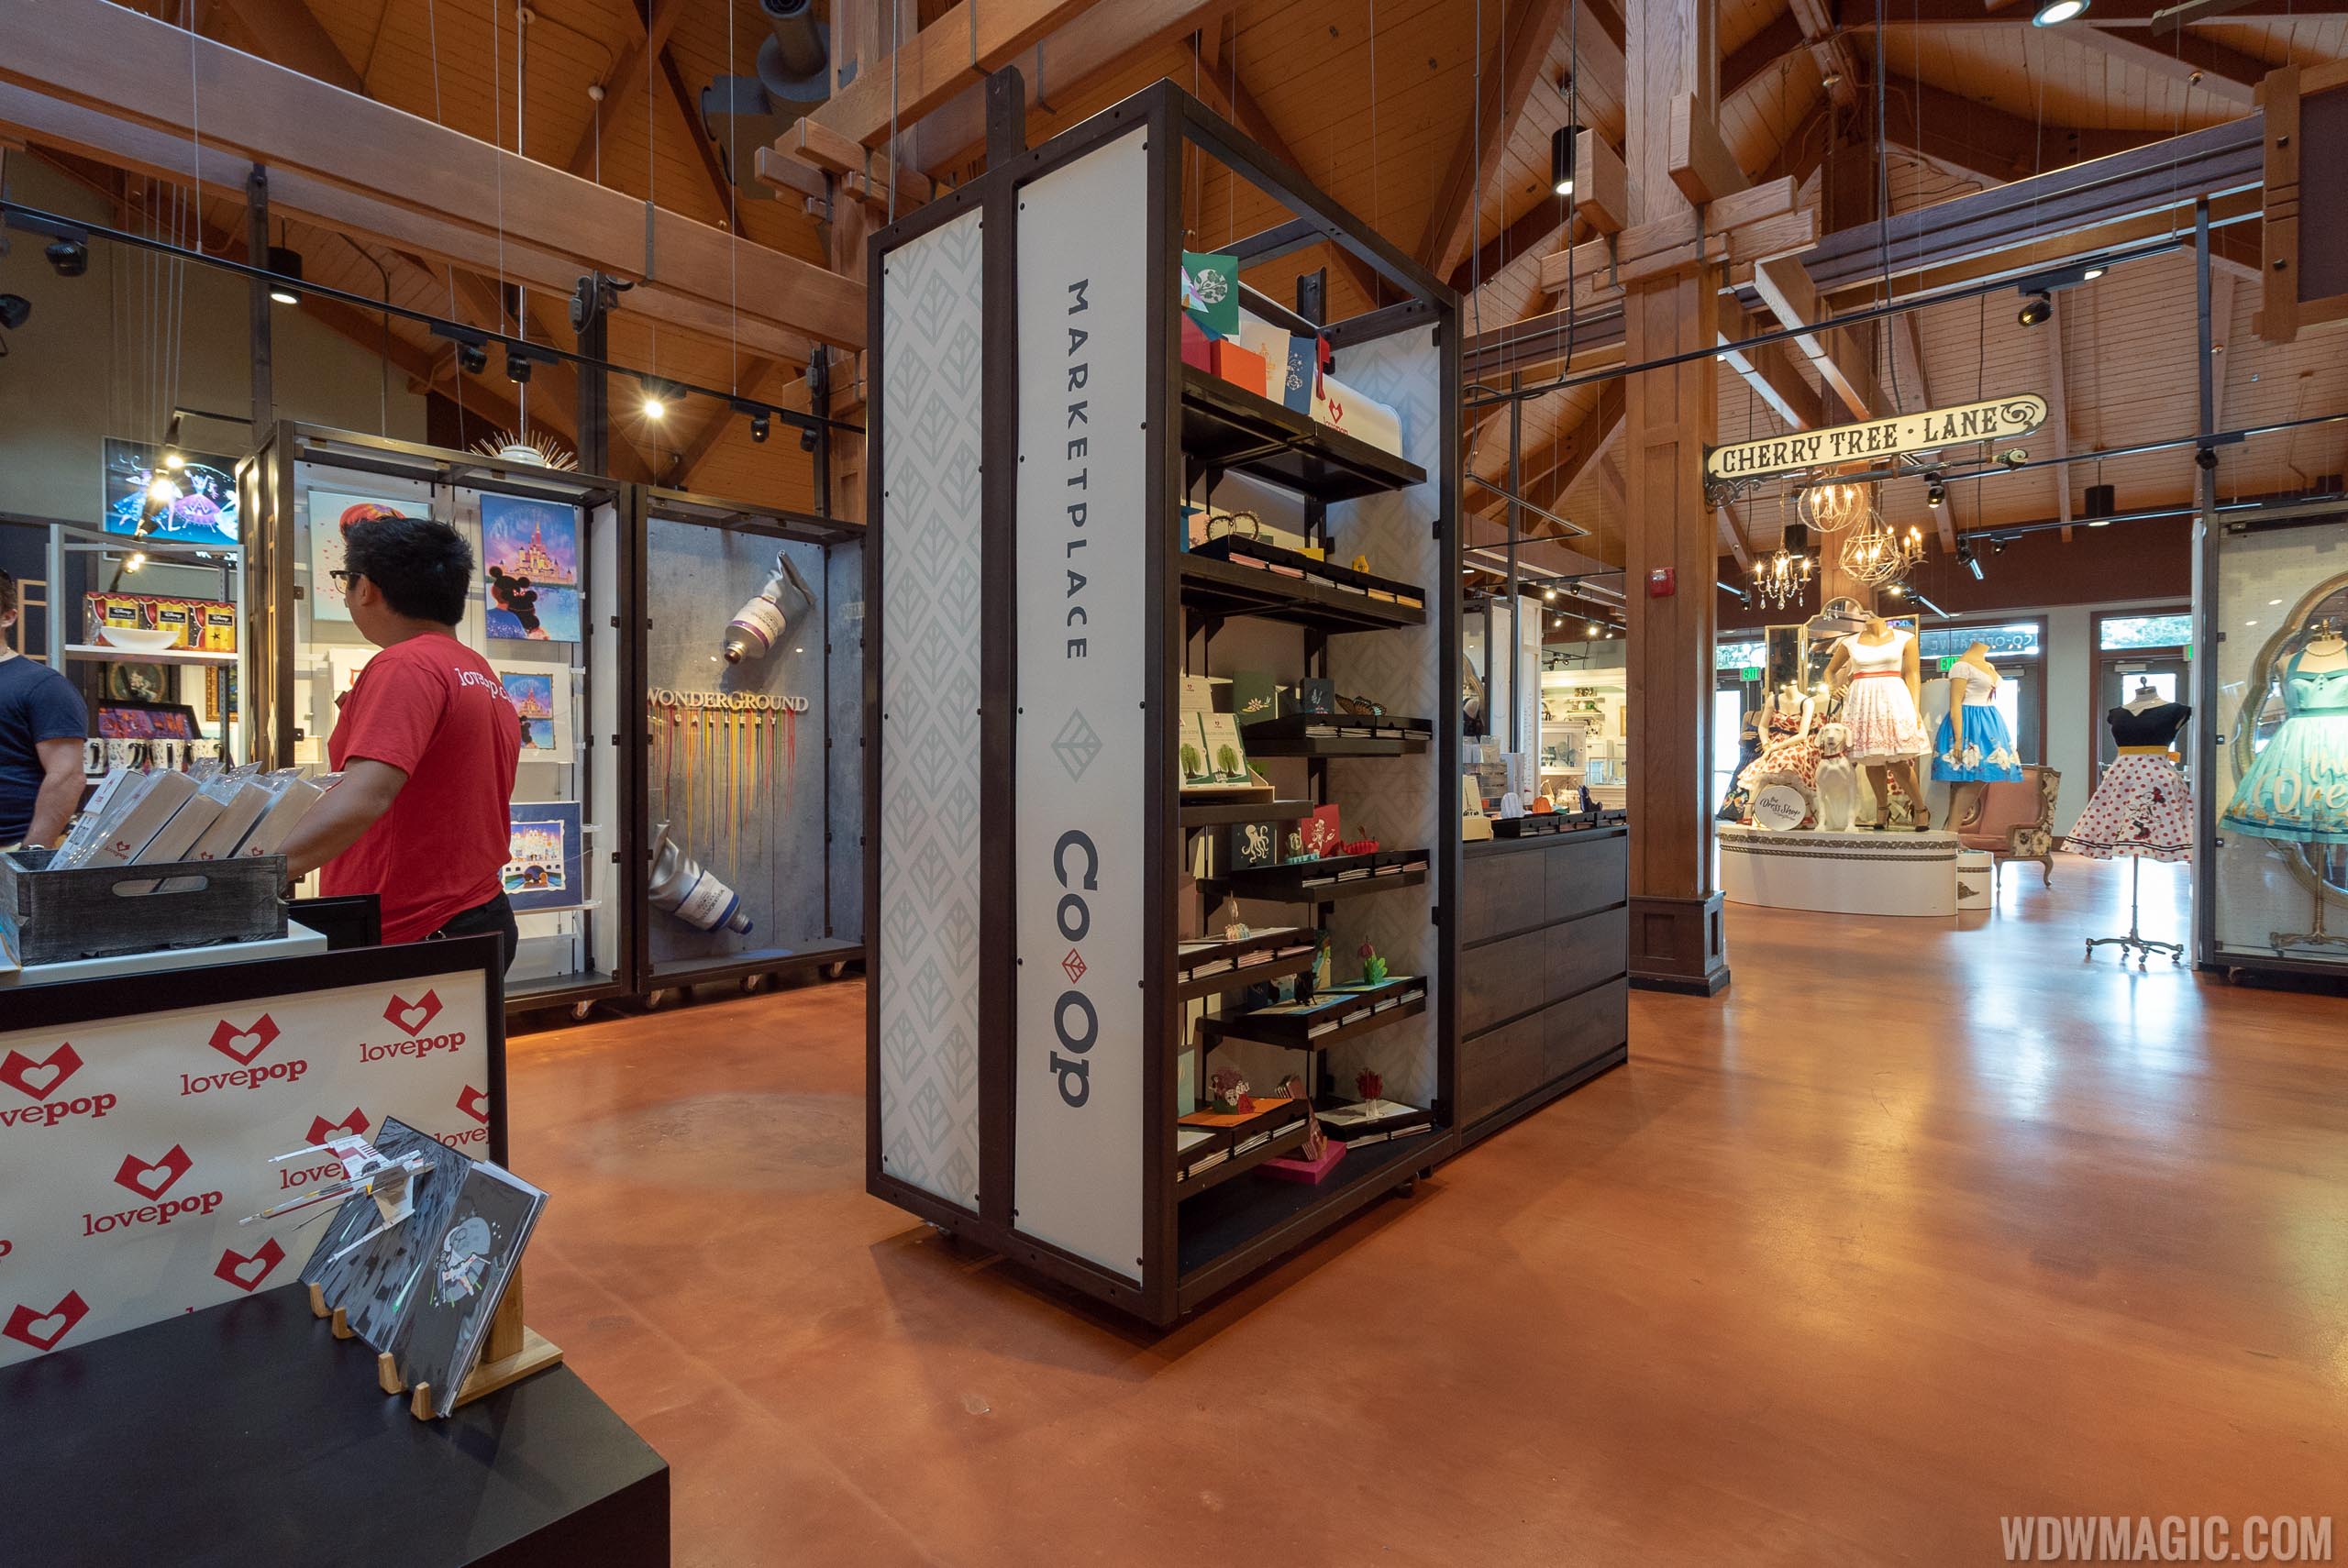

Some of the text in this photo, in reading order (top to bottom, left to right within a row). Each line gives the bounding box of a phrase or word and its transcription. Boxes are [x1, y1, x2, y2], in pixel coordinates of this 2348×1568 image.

[1722, 406, 1999, 473] CHERRY TREE LANE
[1067, 278, 1090, 659] MARKETPLACE
[1743, 667, 1759, 680] EXIT
[648, 686, 809, 712] WONDERGROUND
[674, 714, 777, 724] GALLERY
[1760, 798, 1780, 812] Dress
[1780, 803, 1801, 816] Shop
[359, 1029, 467, 1064] lovepop
[180, 1057, 308, 1096] lovepop
[0, 1092, 117, 1127] vepop
[82, 1188, 223, 1237] lovepop
